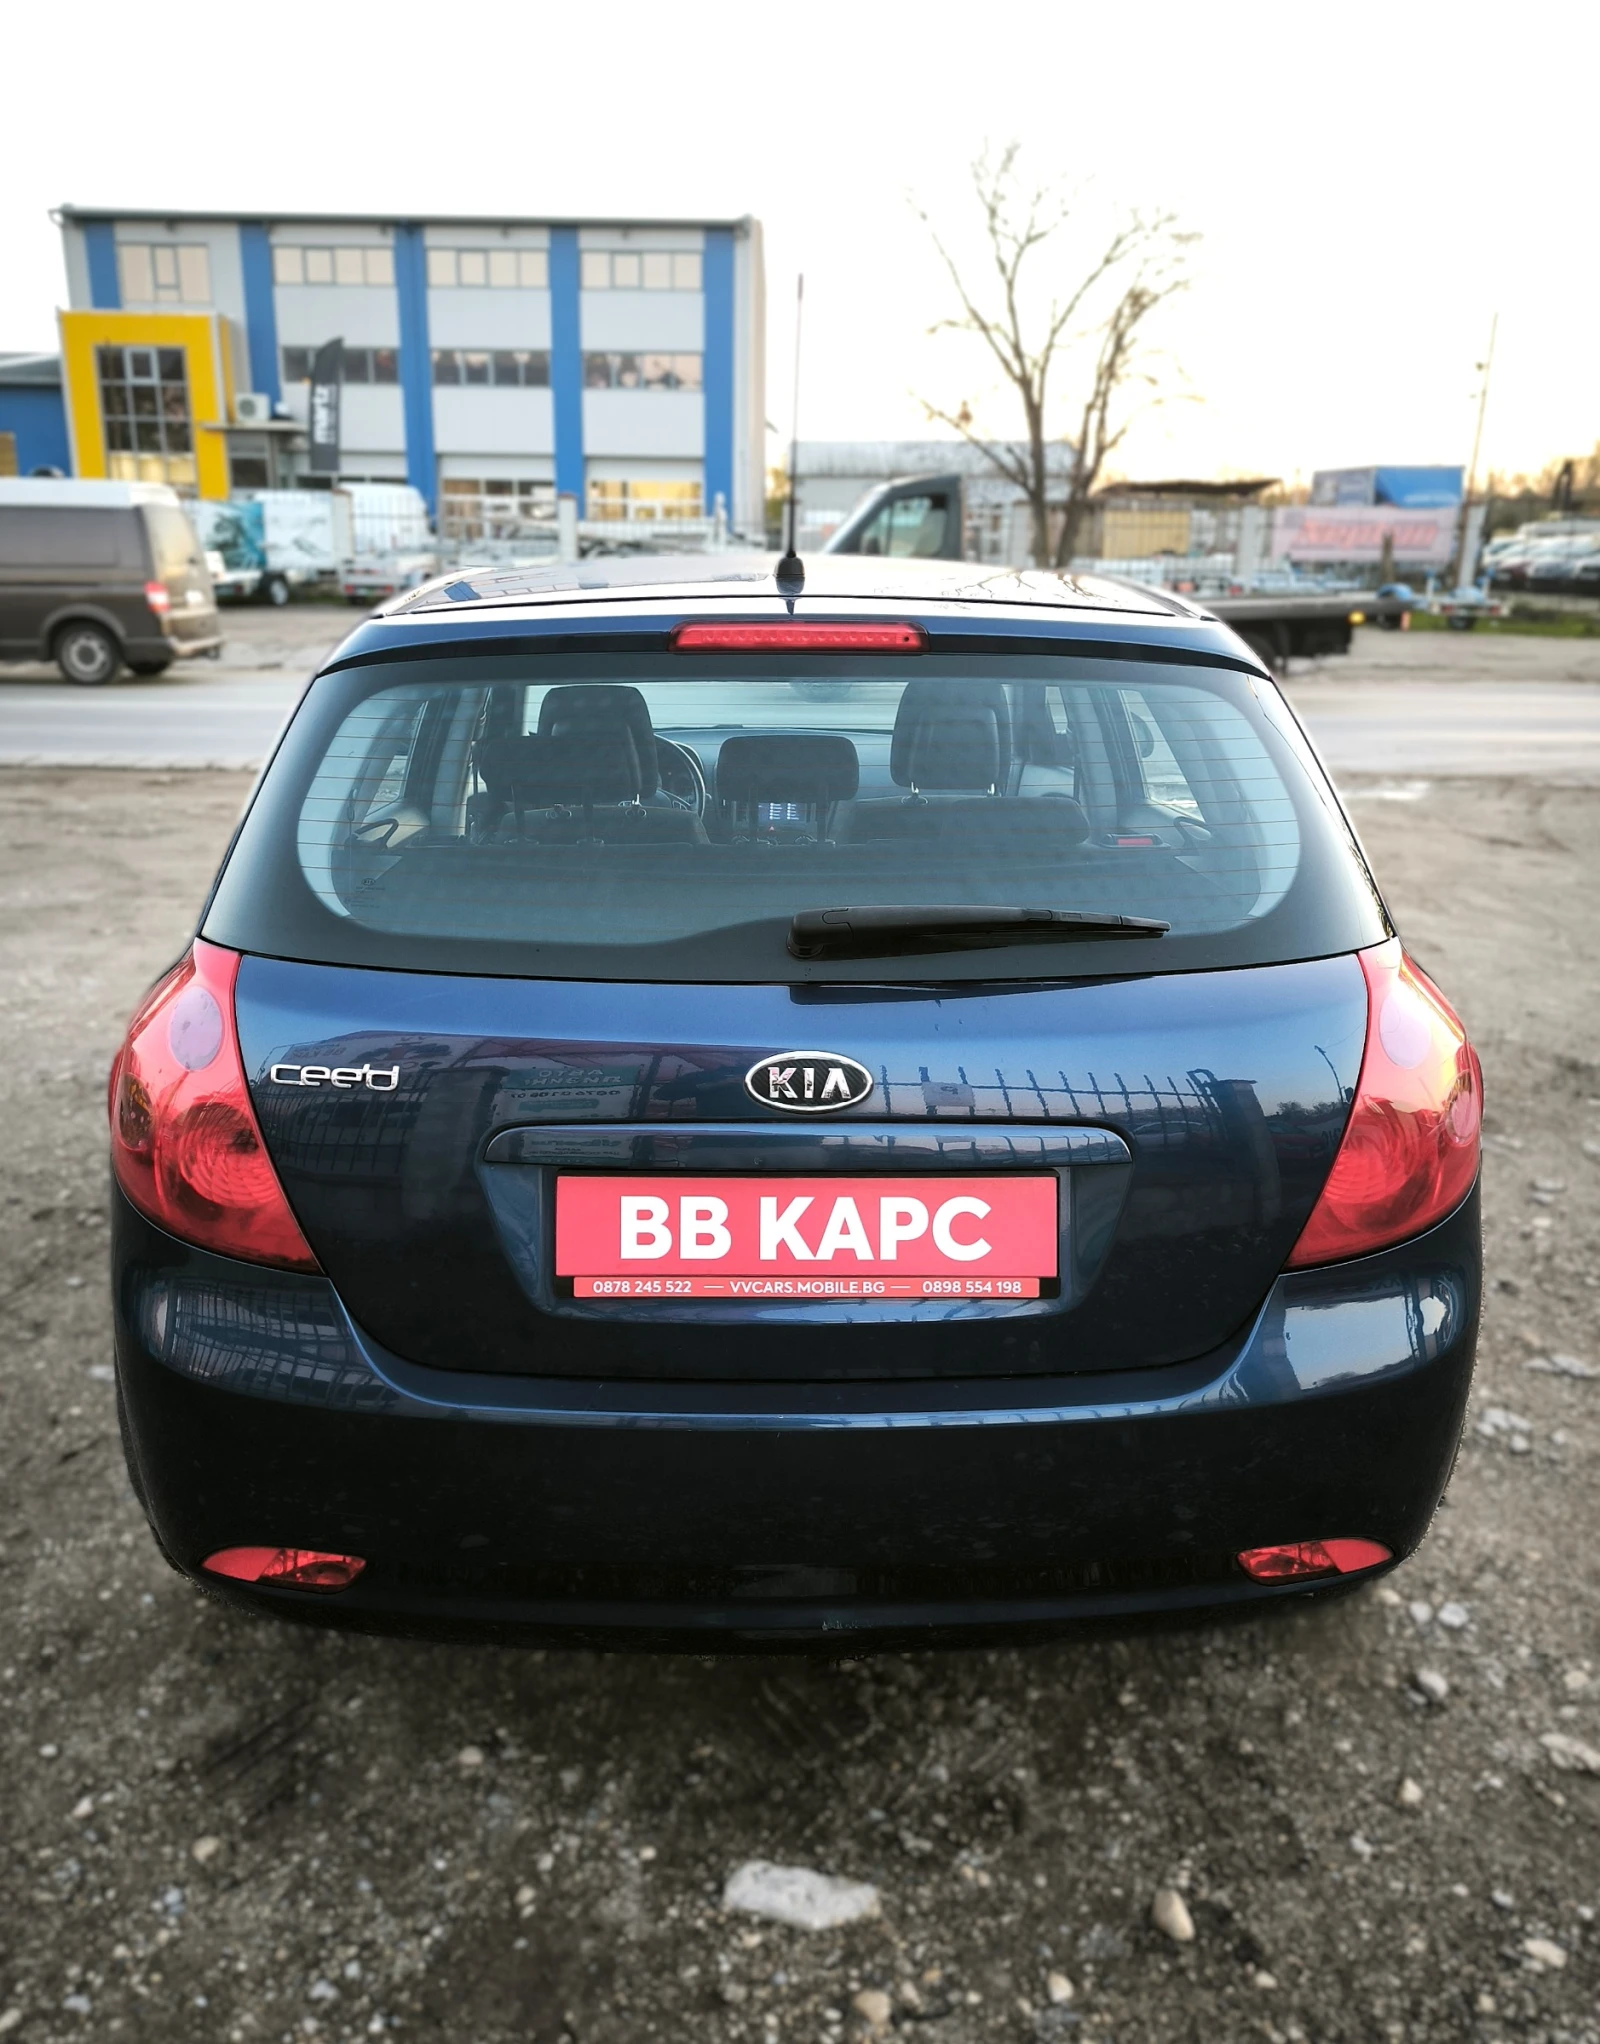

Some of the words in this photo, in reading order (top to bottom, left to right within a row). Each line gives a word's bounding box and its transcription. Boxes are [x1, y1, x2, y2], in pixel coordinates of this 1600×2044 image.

[768, 1066, 852, 1098] KIA
[621, 1196, 731, 1260] ВВ
[760, 1196, 992, 1261] КАРС
[593, 1280, 630, 1294] 0878
[635, 1280, 661, 1293] 245
[666, 1280, 691, 1293] 522
[730, 1280, 885, 1294] VVCARS.MOBILE.BG
[922, 1280, 961, 1294] 0898
[966, 1280, 991, 1293] 554
[995, 1280, 1022, 1294] 198
